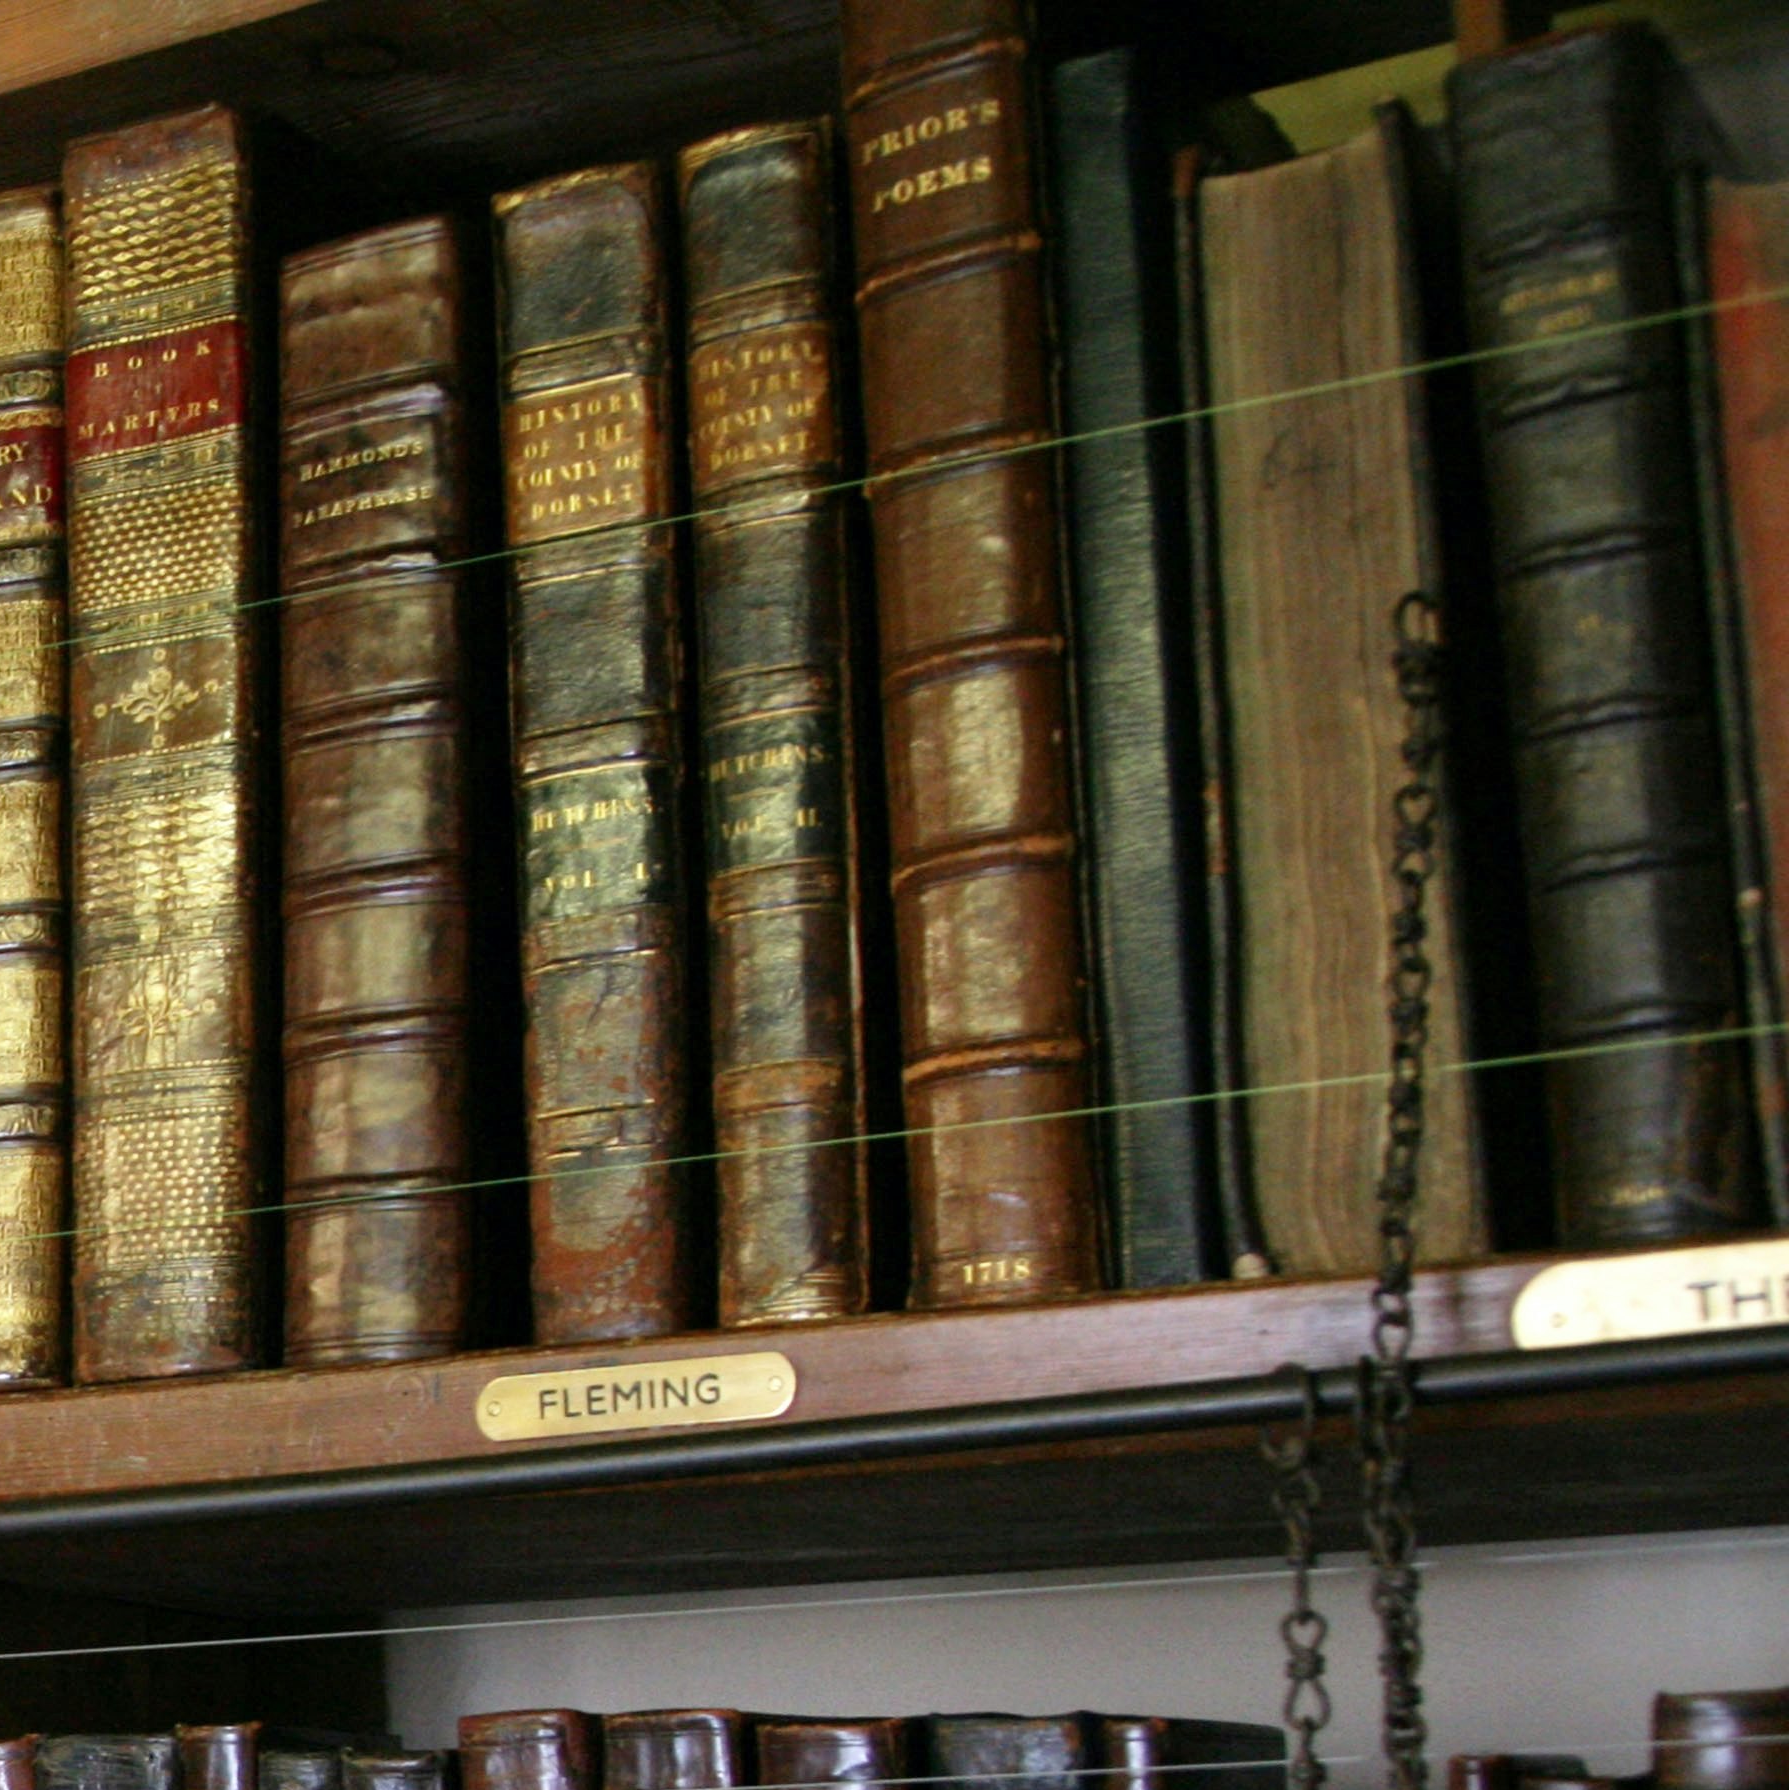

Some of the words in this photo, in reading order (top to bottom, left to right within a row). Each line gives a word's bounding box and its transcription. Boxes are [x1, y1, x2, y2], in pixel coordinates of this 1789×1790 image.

[861, 98, 1001, 166] PRIOR'S
[872, 155, 993, 214] POEMS
[94, 339, 211, 378] BOOK
[78, 398, 220, 440] MARTYRS
[519, 393, 644, 433] HISTORY
[524, 440, 551, 460] OF
[576, 426, 627, 451] THE
[962, 1257, 1033, 1284] 1718
[1686, 1272, 1789, 1323] TH
[538, 1373, 722, 1421] FLEMING
